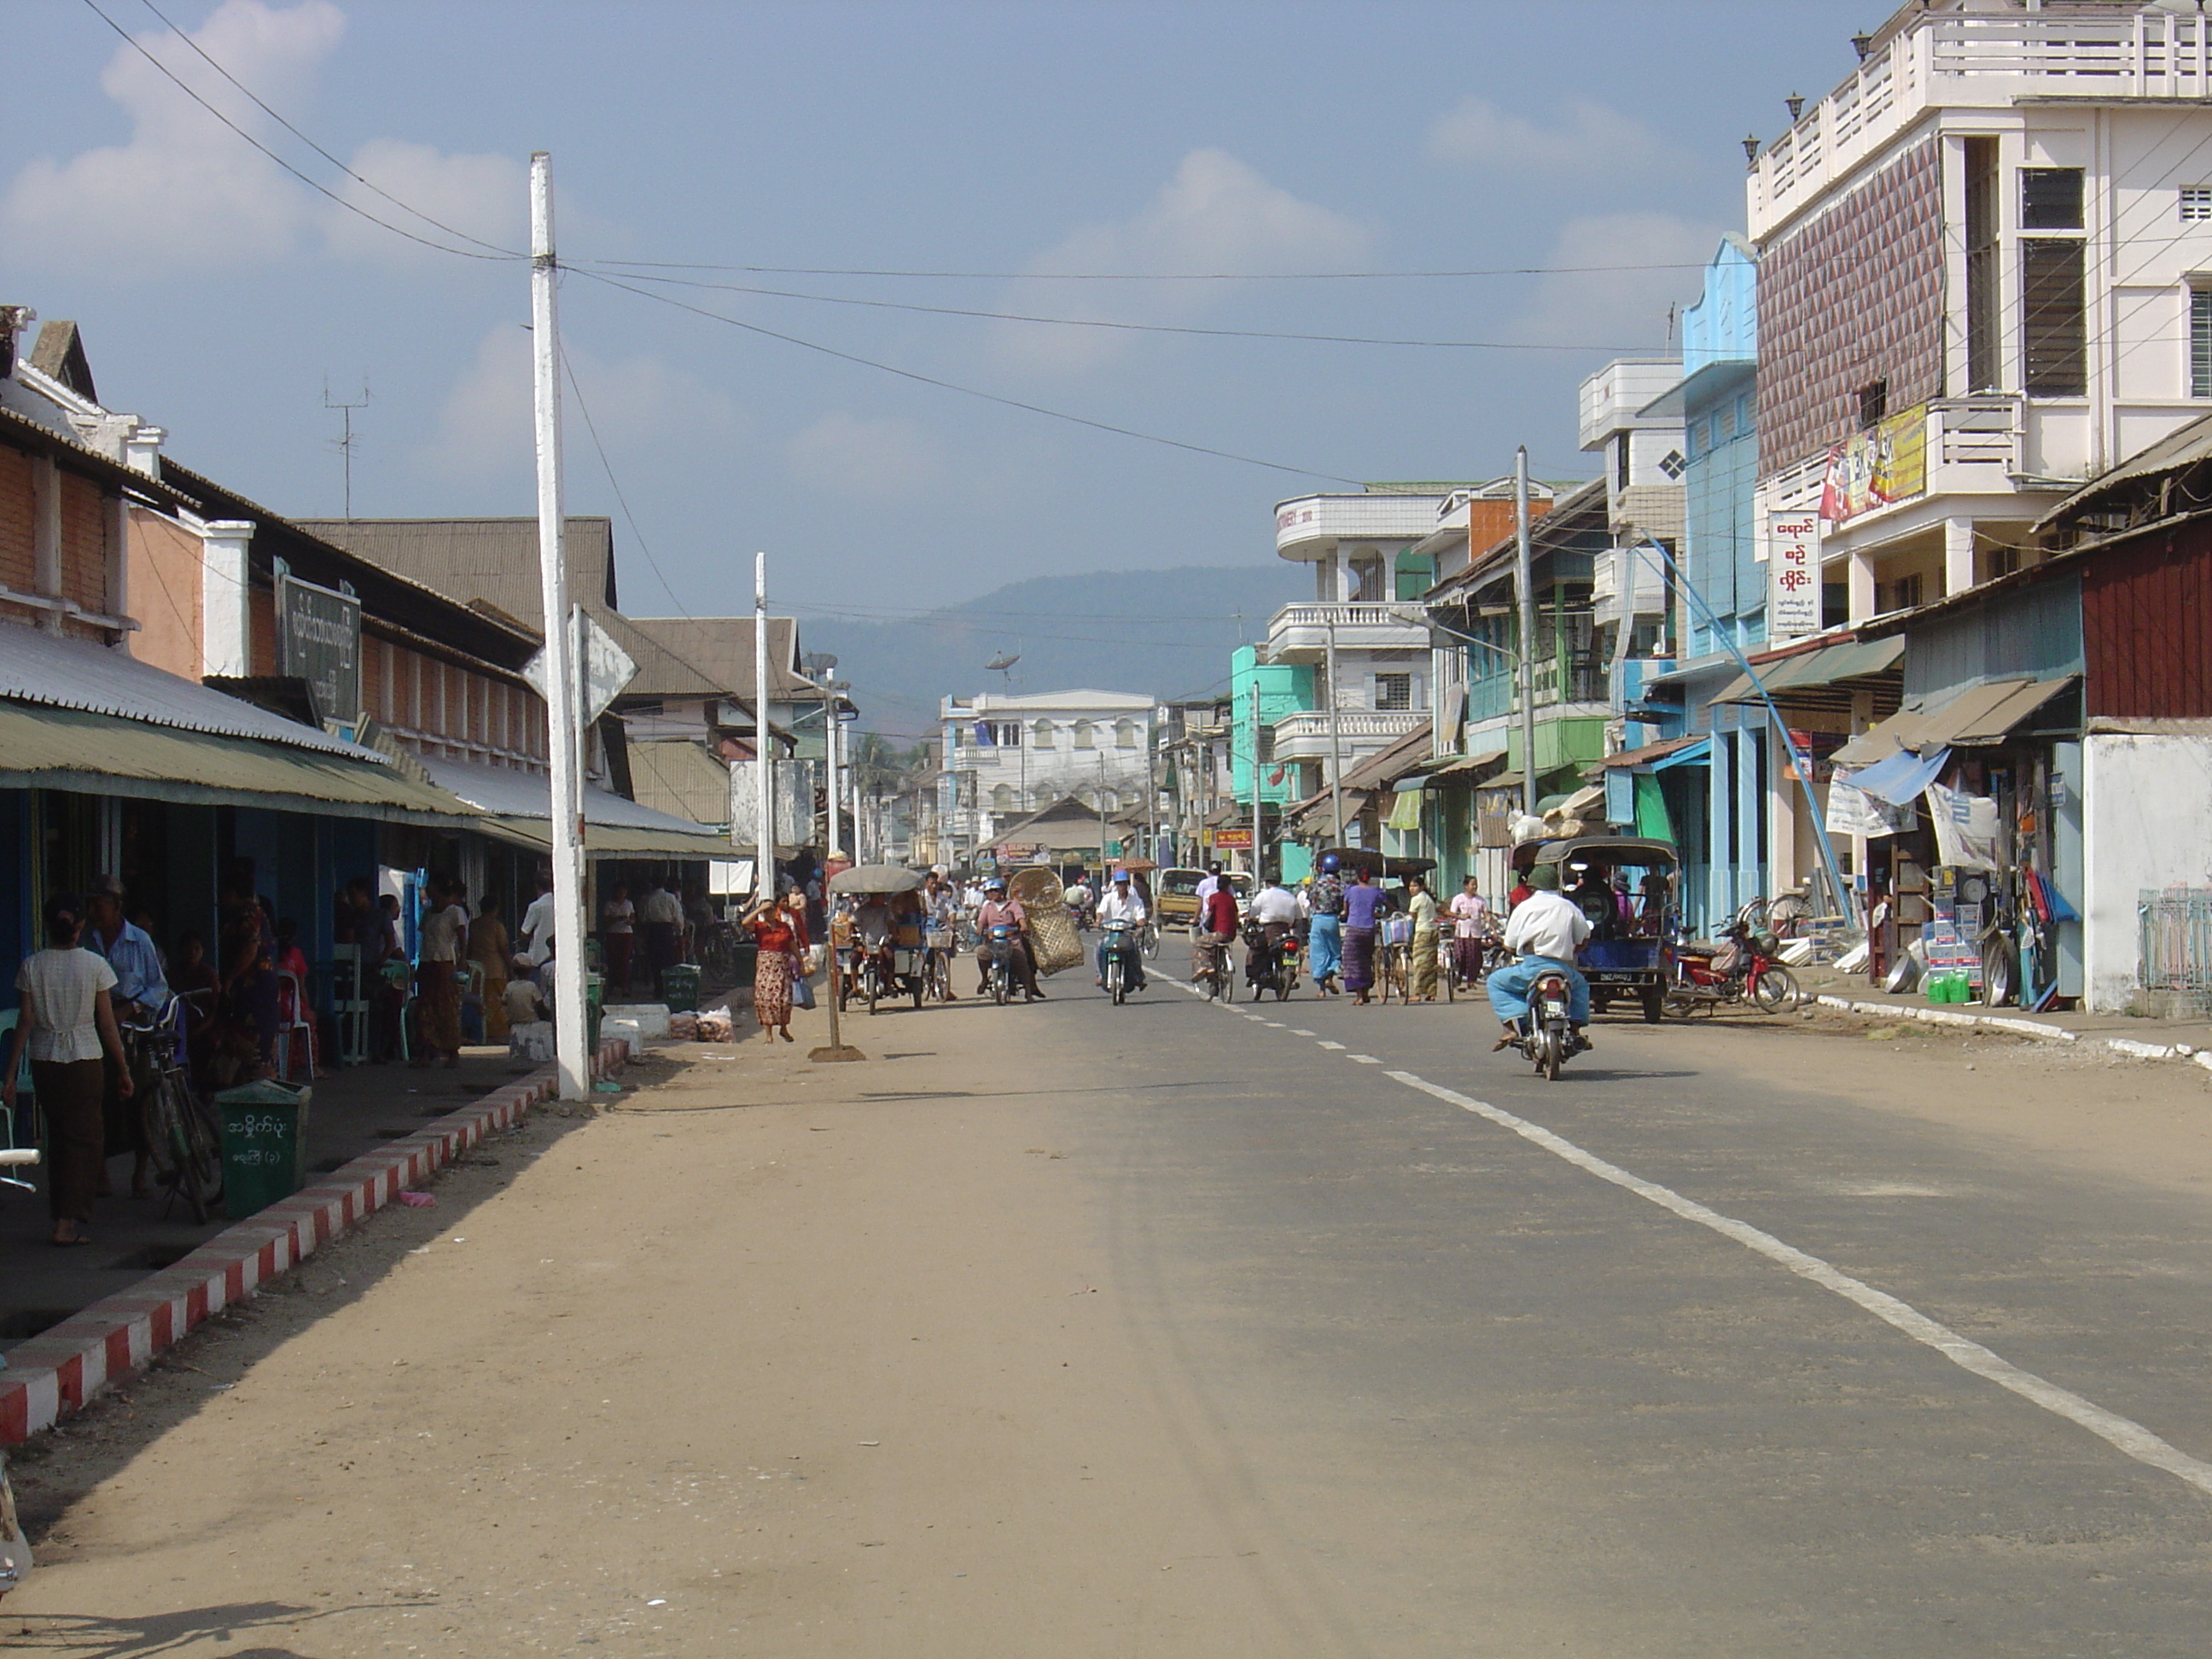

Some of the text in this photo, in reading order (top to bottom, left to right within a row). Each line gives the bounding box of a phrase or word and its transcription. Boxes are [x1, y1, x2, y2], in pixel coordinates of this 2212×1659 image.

[1777, 518, 1814, 538] ရောင်
[1779, 569, 1812, 592] လှိုင်း
[228, 1115, 287, 1138] အမှိုက်ပုံး
